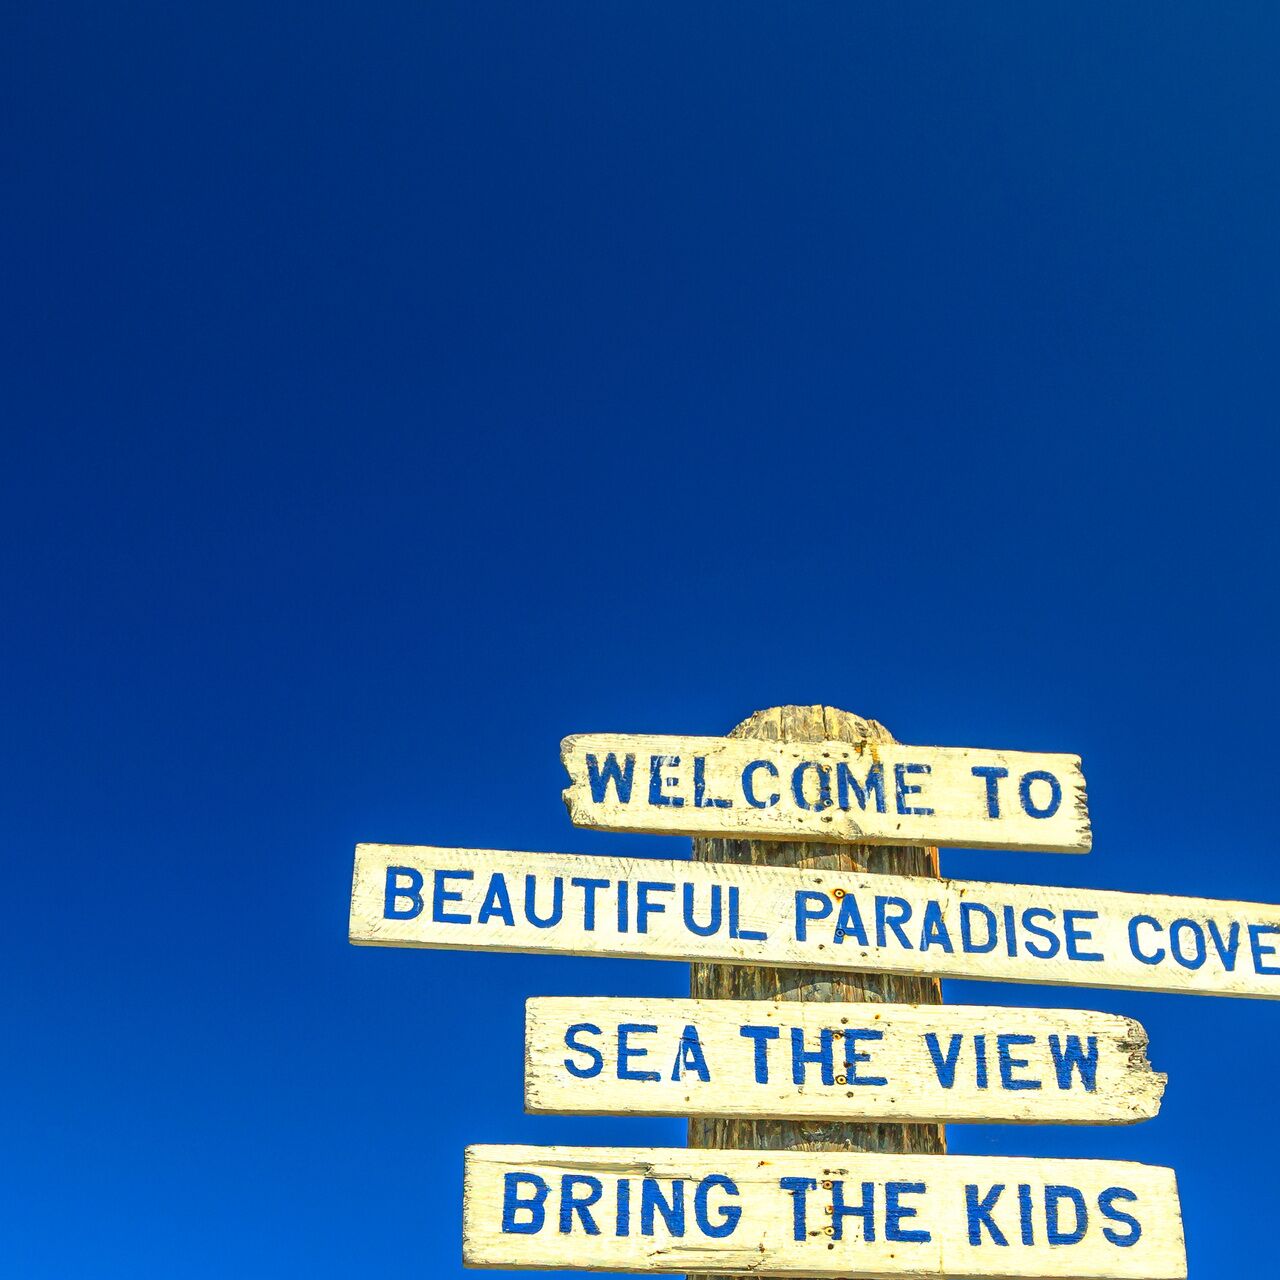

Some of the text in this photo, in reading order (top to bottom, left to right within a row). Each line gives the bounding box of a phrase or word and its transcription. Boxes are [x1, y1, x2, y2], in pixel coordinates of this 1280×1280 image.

[588, 755, 1061, 818] WELCOME TO
[384, 867, 767, 940] BEAUTIFUL
[796, 888, 1104, 961] PARADISE
[565, 1024, 1097, 1090] SEA THE VIEW
[502, 1172, 1140, 1246] BRING THE KIDS
